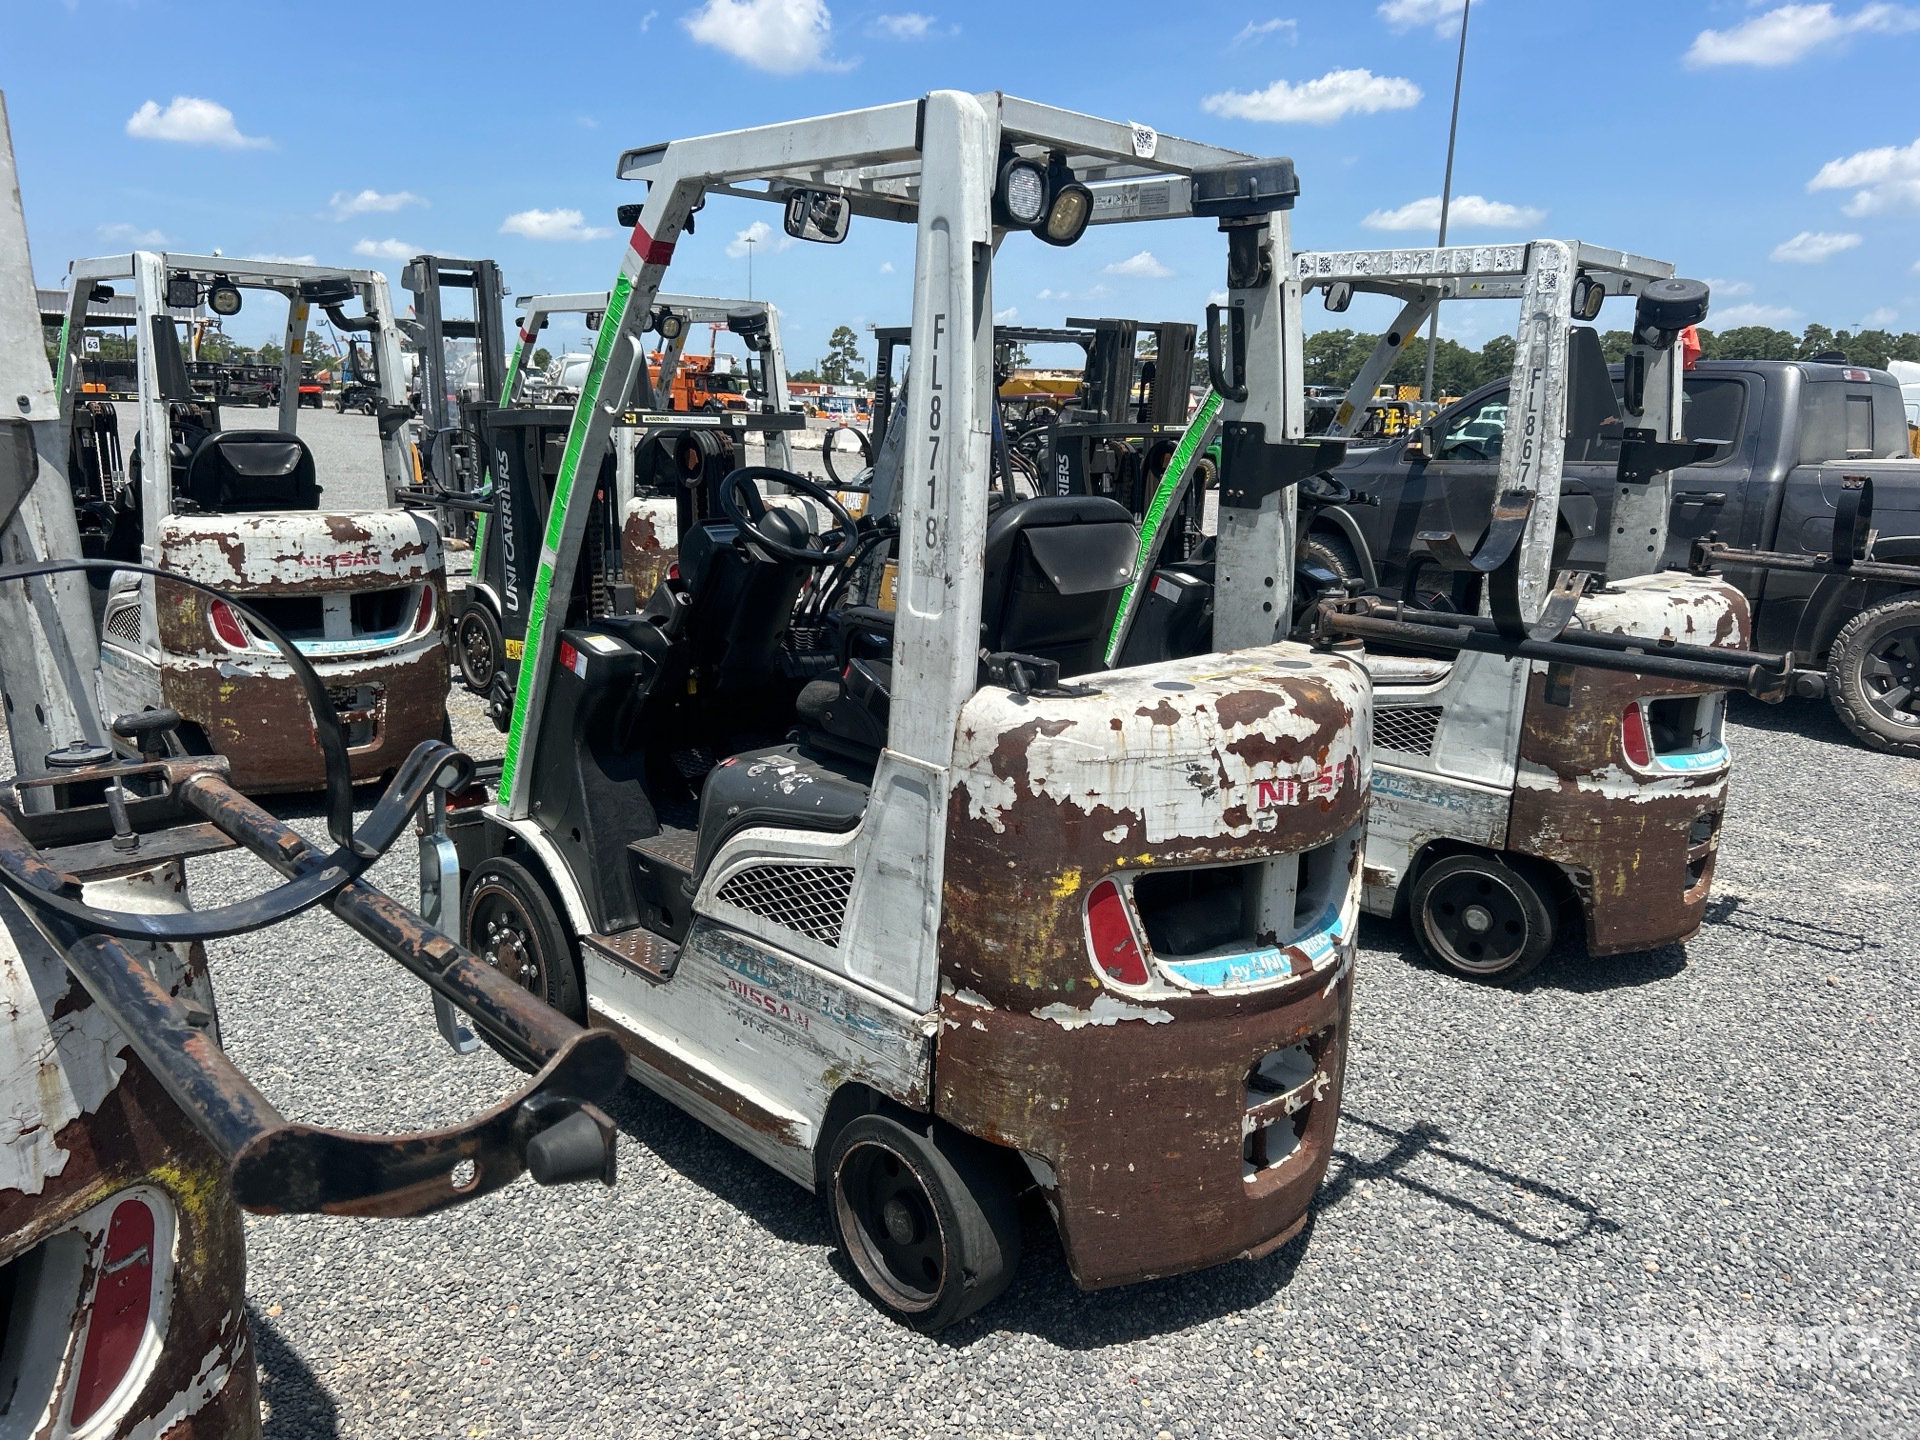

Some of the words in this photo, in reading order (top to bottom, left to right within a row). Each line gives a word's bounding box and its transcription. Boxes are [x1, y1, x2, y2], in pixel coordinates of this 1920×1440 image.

[87, 341, 98, 349] 63
[925, 313, 945, 549] FL8718
[1518, 368, 1541, 490] FL867
[1229, 963, 1251, 980] by
